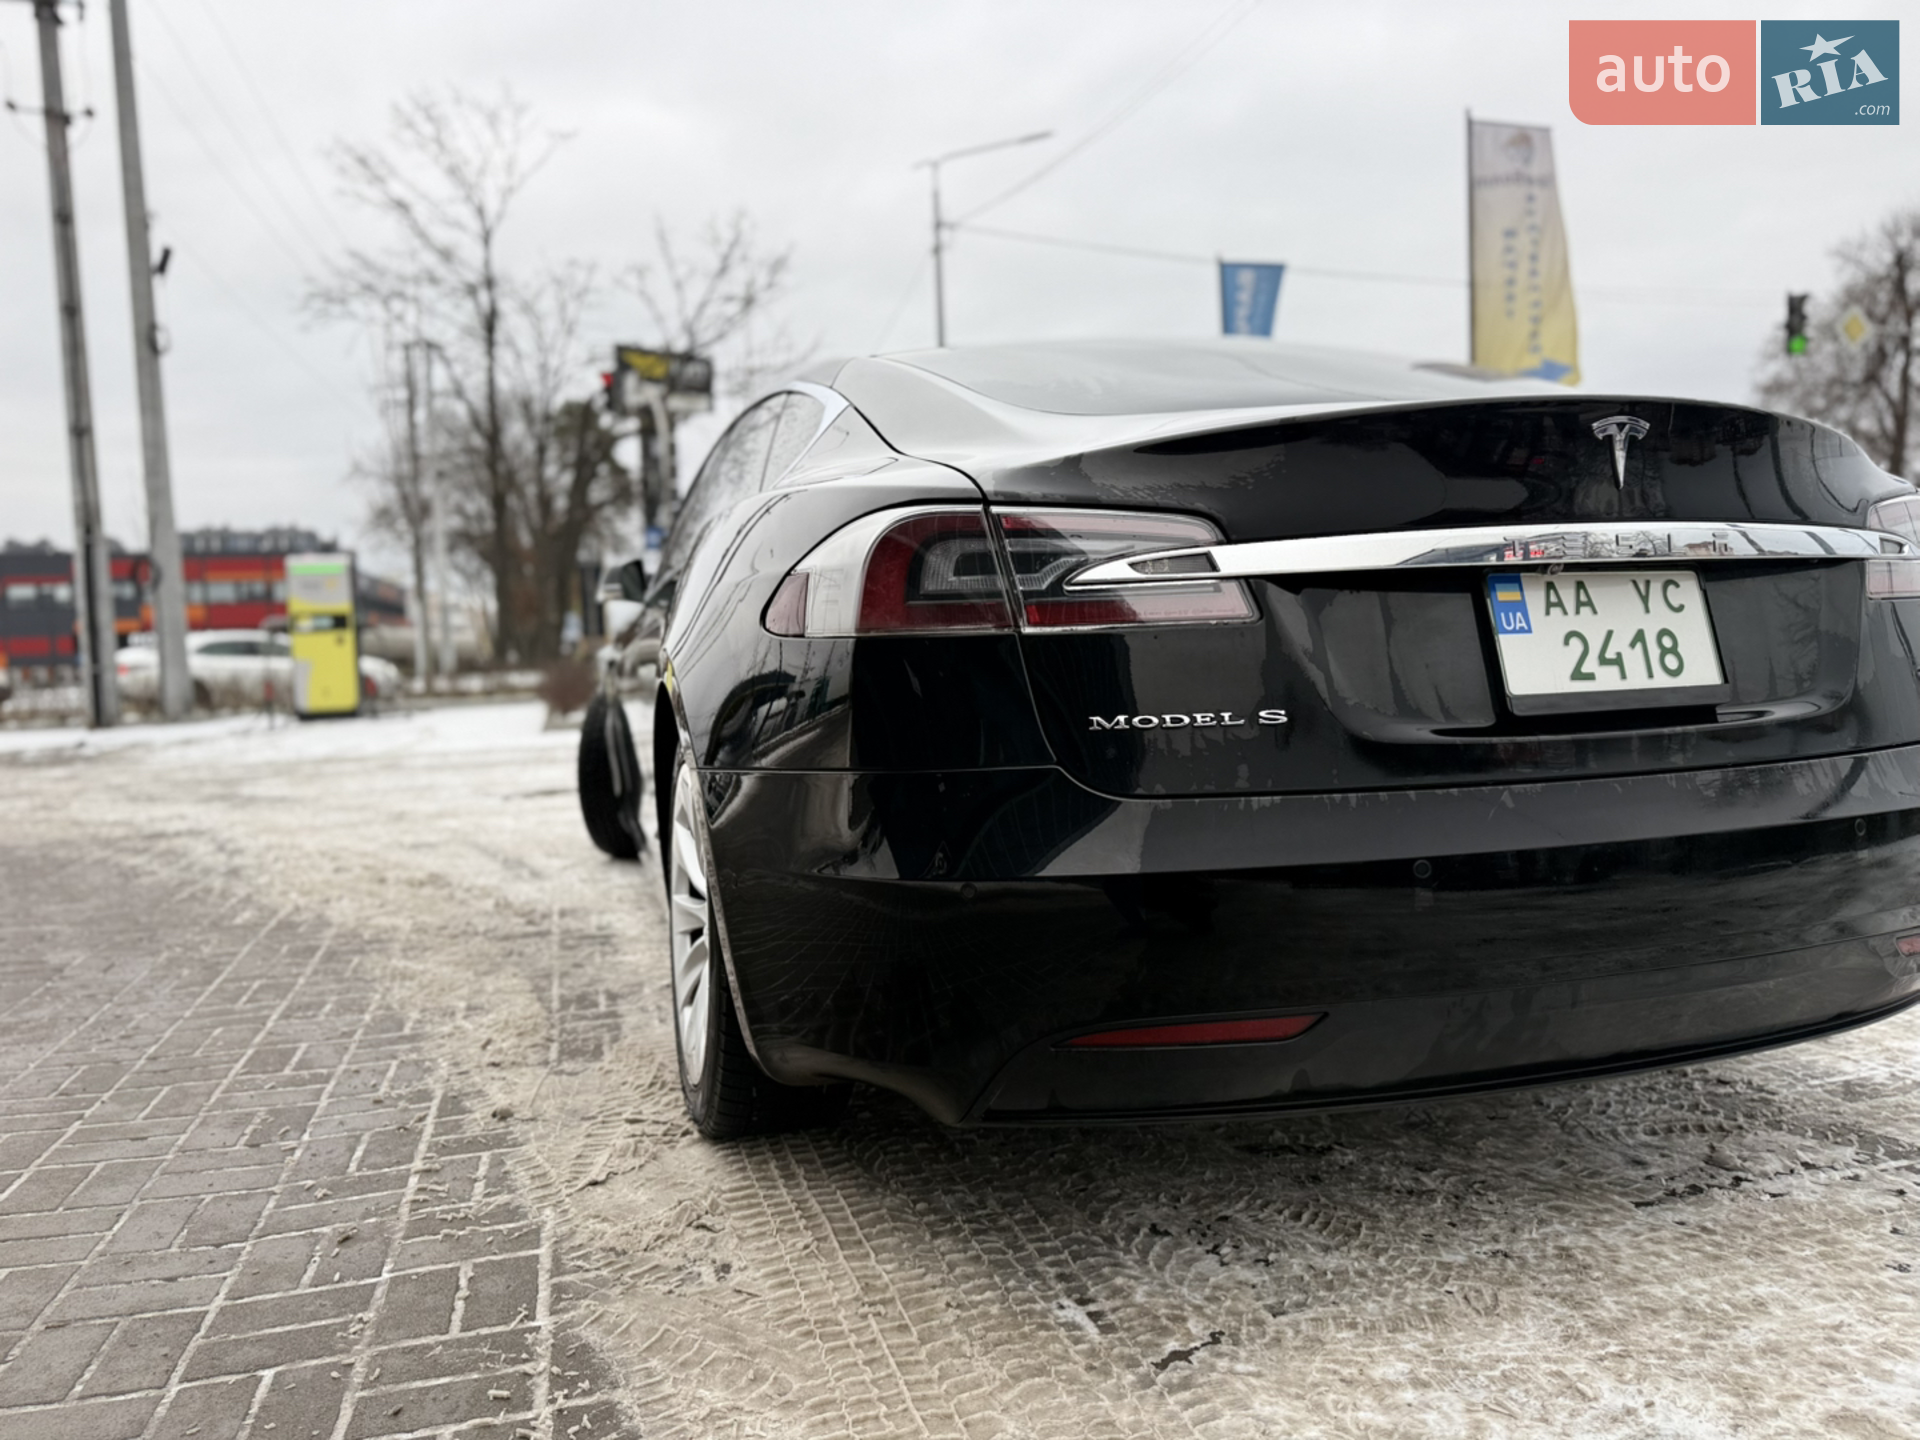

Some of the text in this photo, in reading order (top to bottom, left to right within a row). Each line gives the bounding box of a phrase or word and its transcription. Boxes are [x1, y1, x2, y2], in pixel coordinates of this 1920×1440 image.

[1544, 578, 1686, 616] AA YC
[1500, 611, 1529, 631] UA
[1563, 627, 1685, 681] 2418
[1088, 709, 1289, 731] MODEL S
